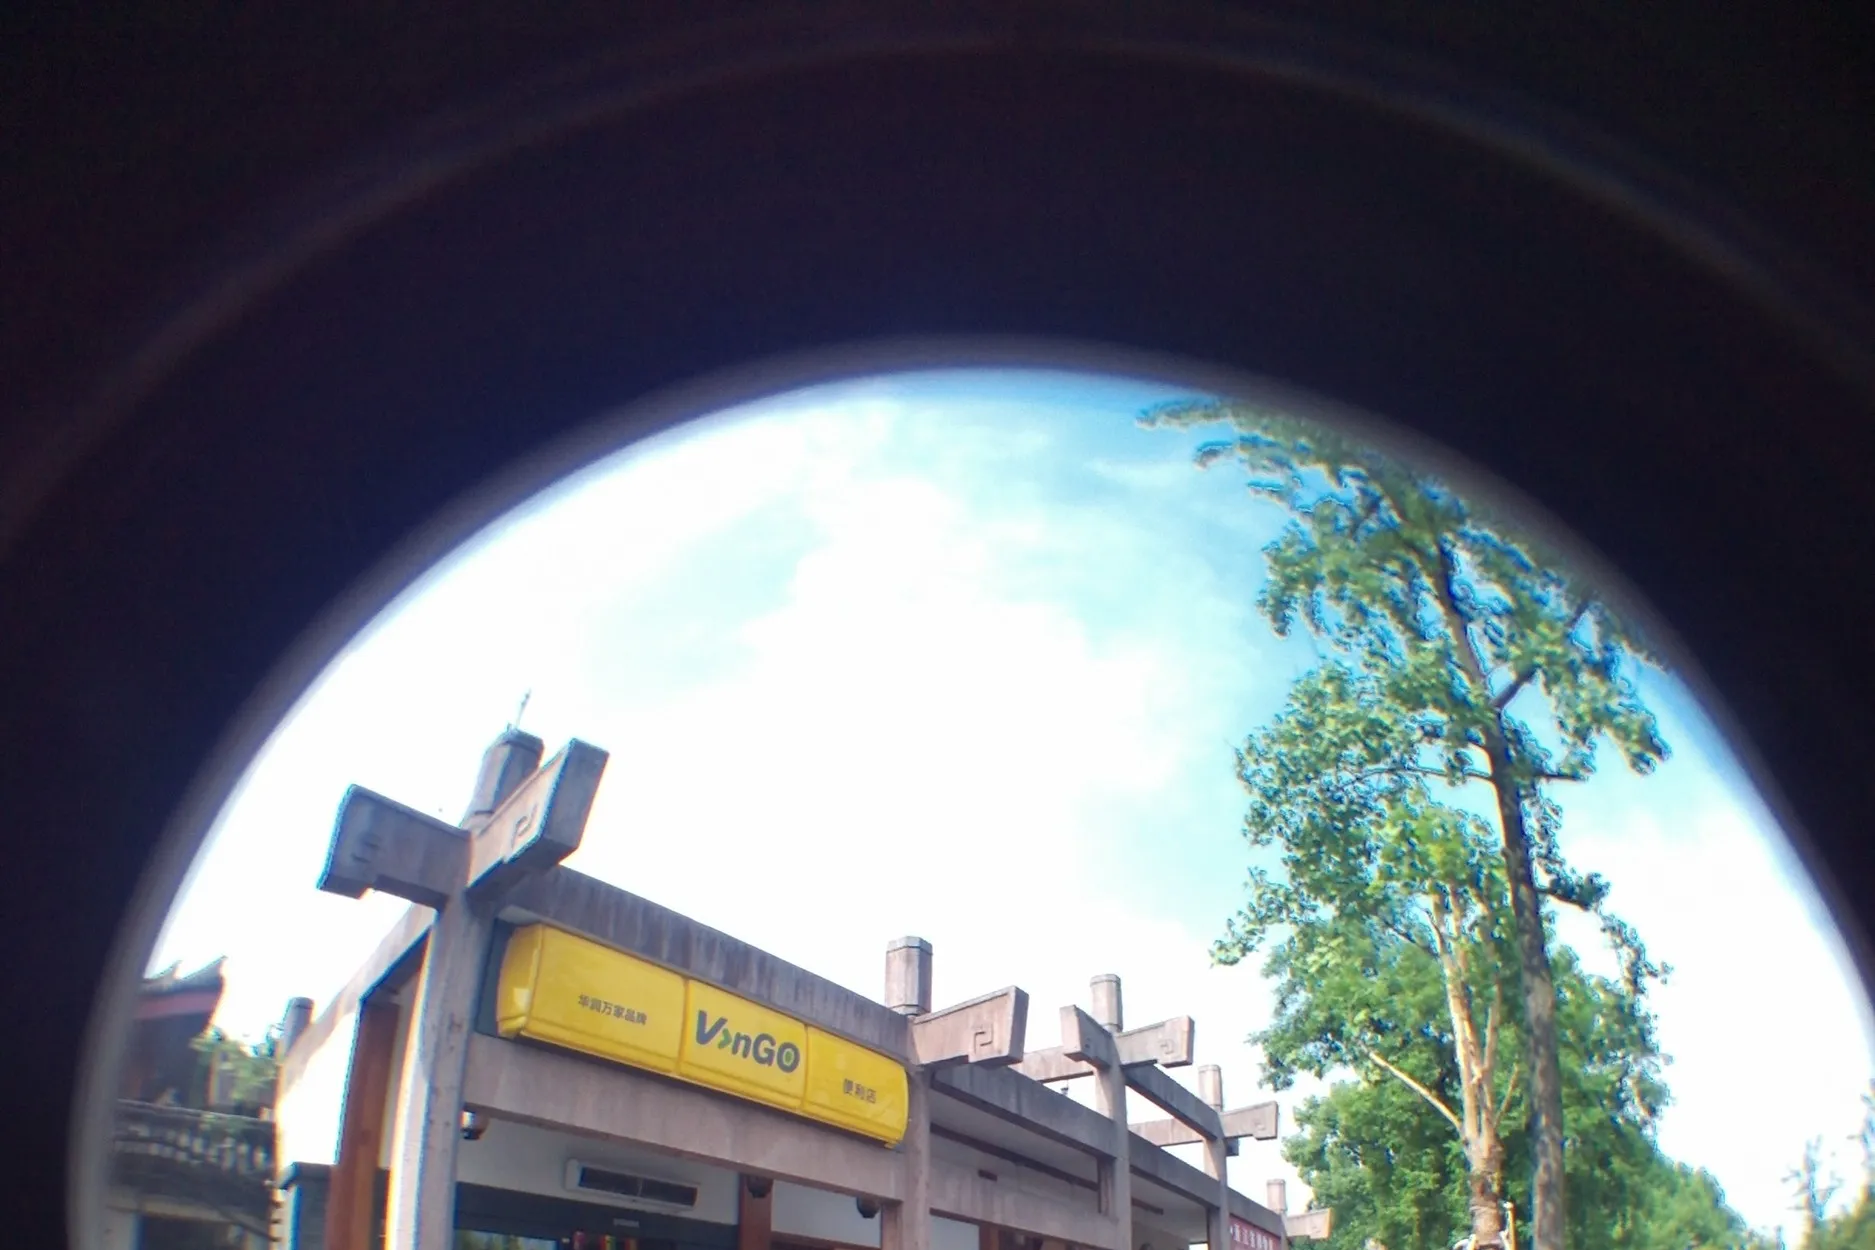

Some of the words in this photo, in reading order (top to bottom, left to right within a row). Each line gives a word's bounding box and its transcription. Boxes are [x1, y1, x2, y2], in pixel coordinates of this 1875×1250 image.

[577, 993, 648, 1026] 华润万家品牌
[843, 1078, 877, 1104] 便利店
